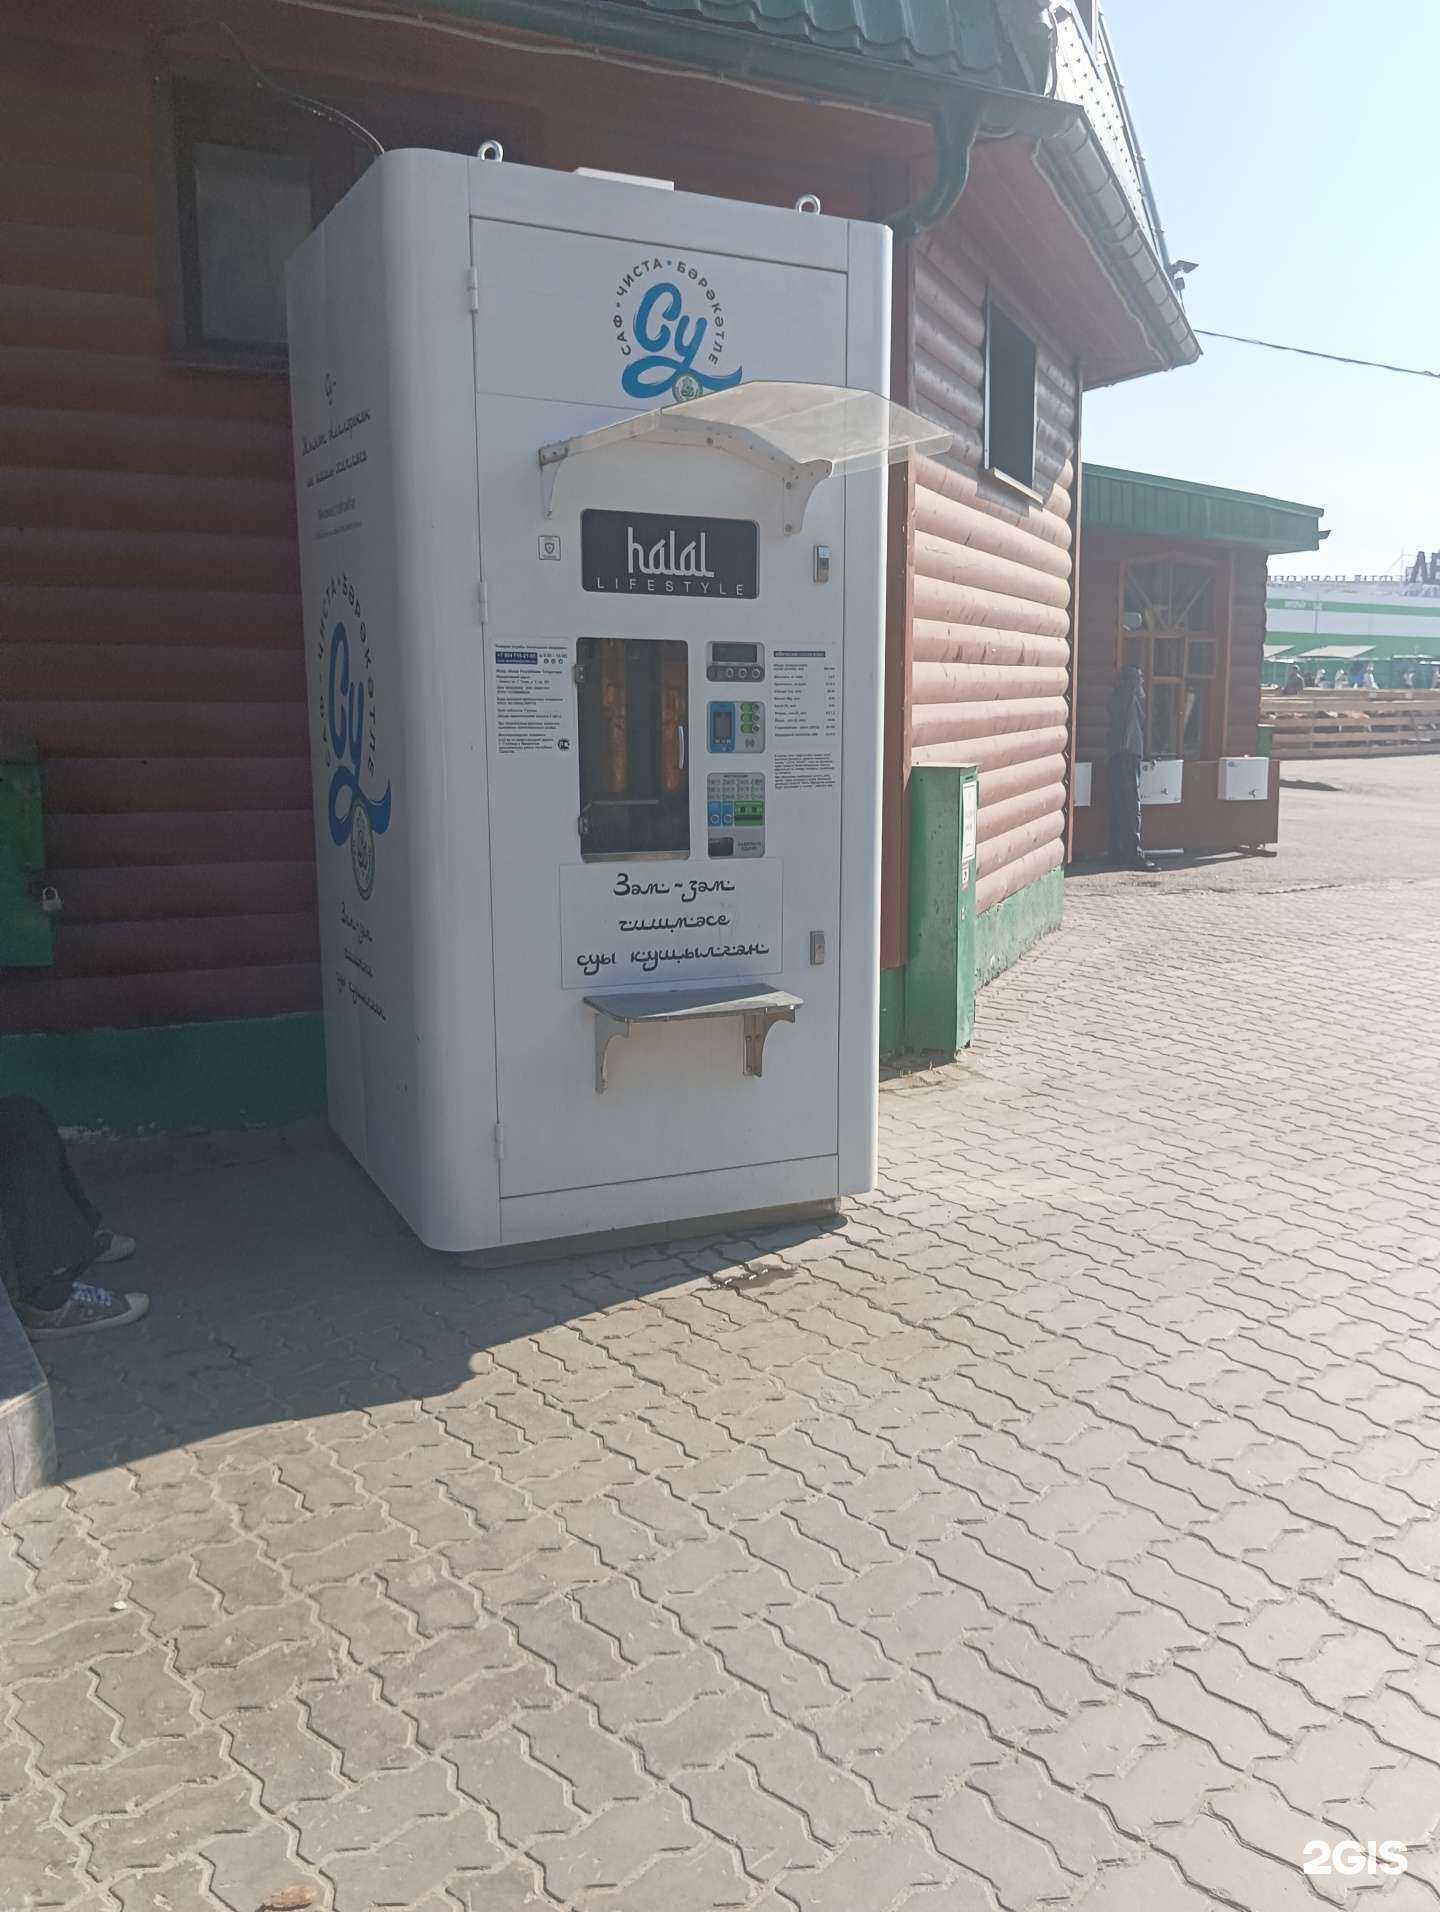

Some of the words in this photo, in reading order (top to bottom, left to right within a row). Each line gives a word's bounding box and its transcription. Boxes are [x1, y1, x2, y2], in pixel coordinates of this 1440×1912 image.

[616, 258, 664, 298] ЧИСТА
[611, 314, 632, 356] САФ
[627, 526, 715, 578] halal
[597, 577, 744, 597] LIFESTYLE
[576, 951, 617, 976] суы
